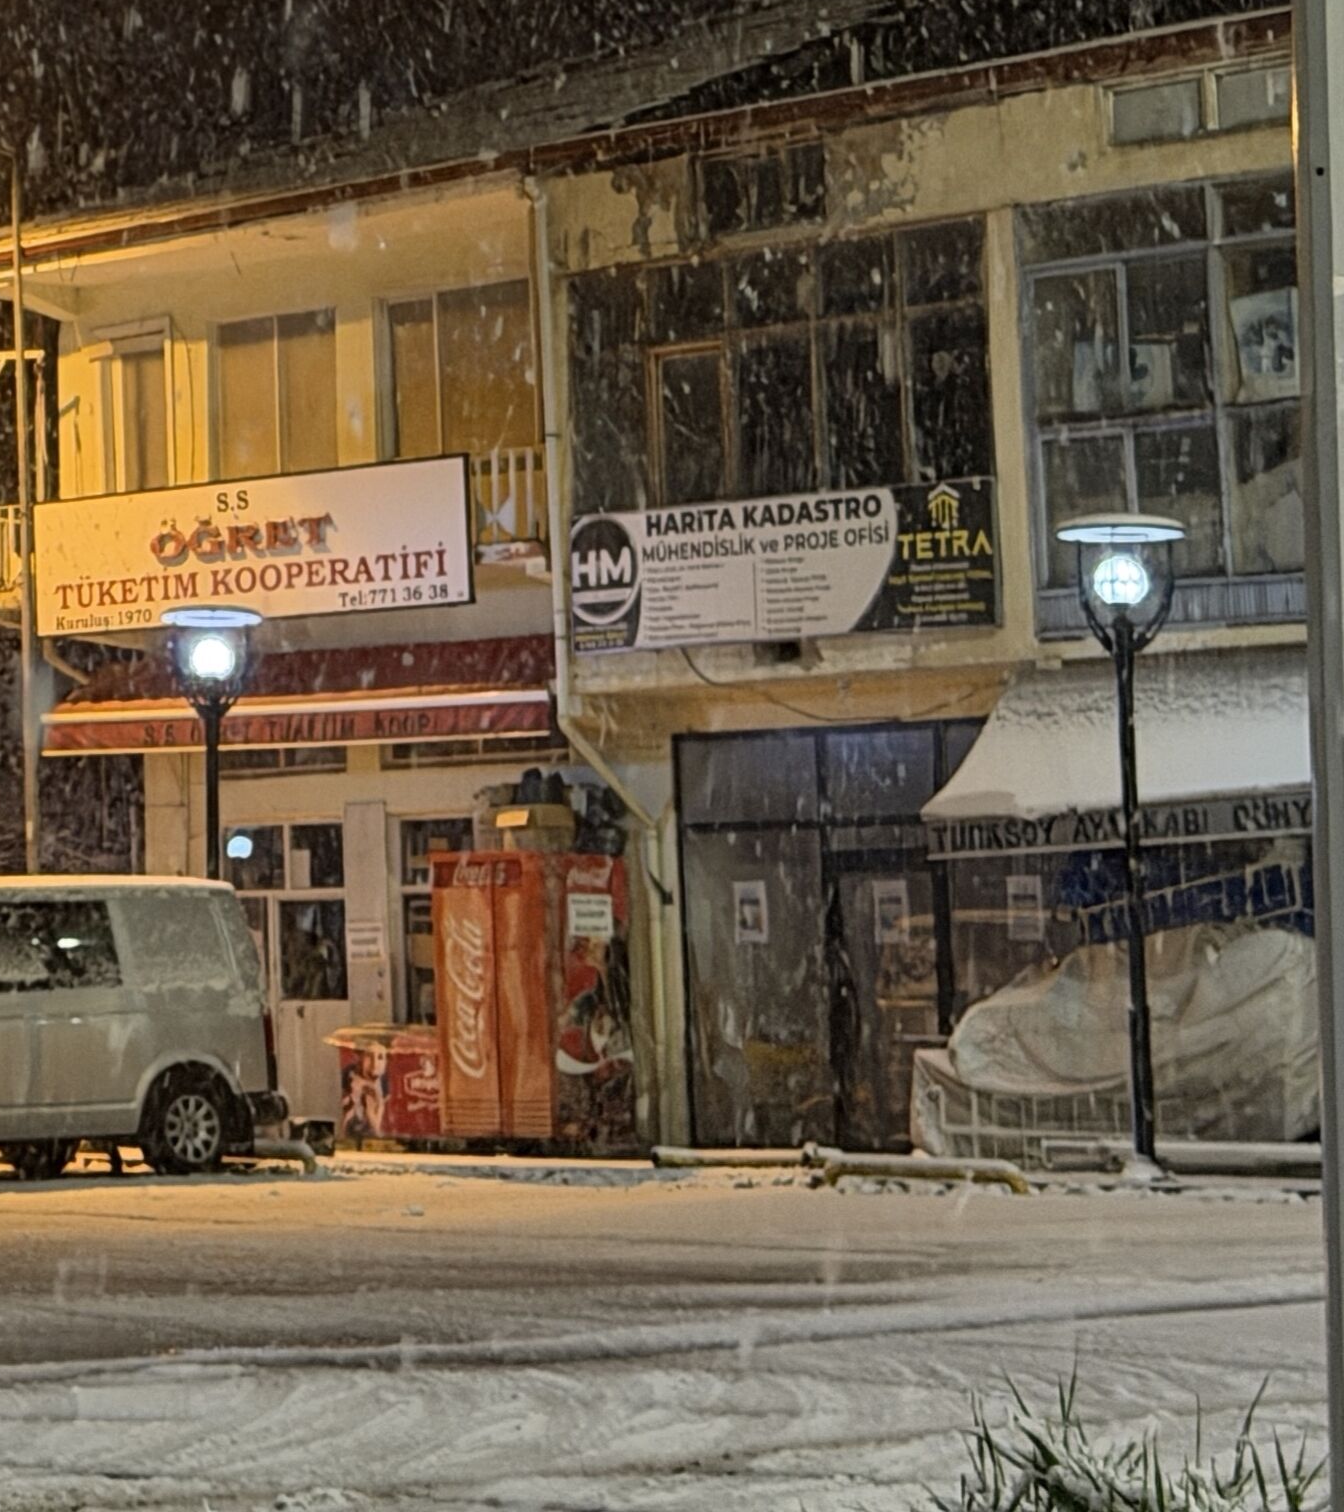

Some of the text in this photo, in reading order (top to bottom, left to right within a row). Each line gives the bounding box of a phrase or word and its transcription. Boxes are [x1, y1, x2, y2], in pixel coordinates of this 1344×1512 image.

[742, 494, 882, 529] KADASTRO
[642, 519, 890, 563] MÜHENDİSLİK ve PROJE OFİSİ
[897, 529, 993, 561] TETRA
[54, 541, 448, 610] TÜKETİM KOOPERATİFİ
[571, 546, 633, 588] HM
[402, 587, 424, 602] 36
[428, 584, 450, 600] 38
[118, 609, 153, 625] 1970
